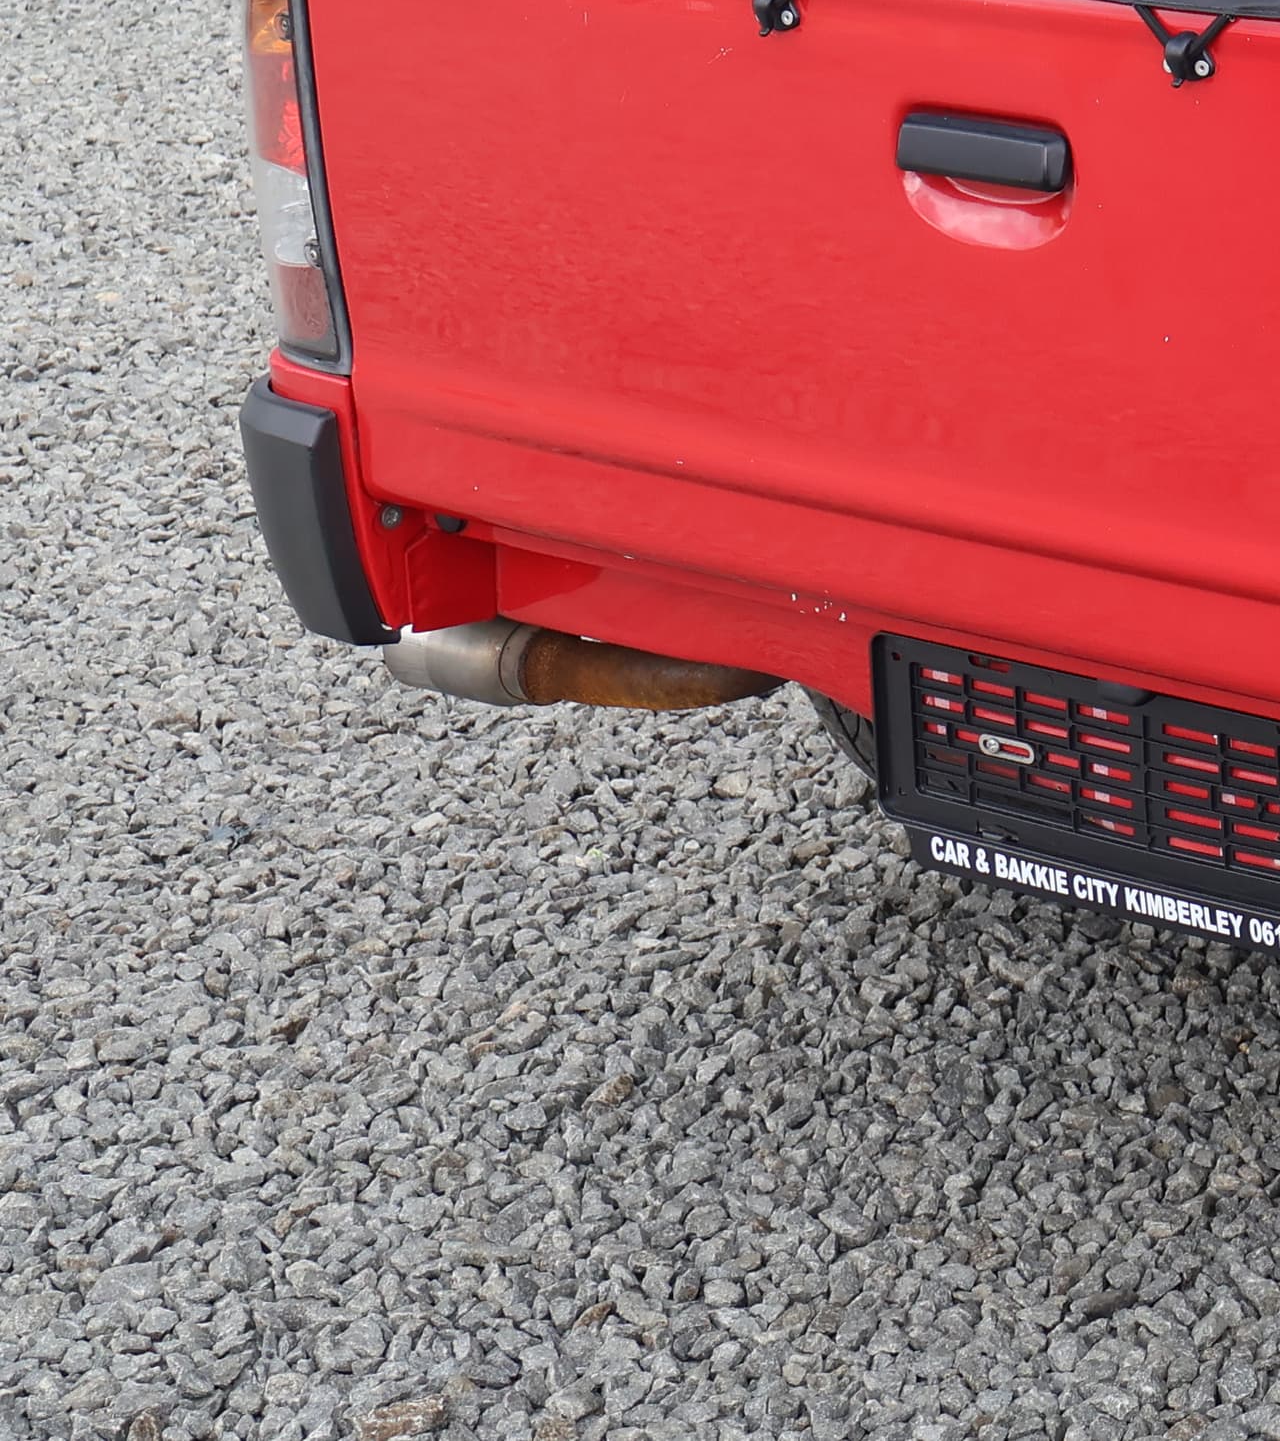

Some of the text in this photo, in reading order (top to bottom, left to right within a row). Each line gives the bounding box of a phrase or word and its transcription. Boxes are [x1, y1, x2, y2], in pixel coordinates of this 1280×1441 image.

[930, 835, 971, 870] CAR
[975, 847, 990, 875] &
[994, 852, 1070, 896] BAKKIE
[1072, 874, 1119, 907] CITY
[1124, 886, 1244, 938] KIMBERLEY
